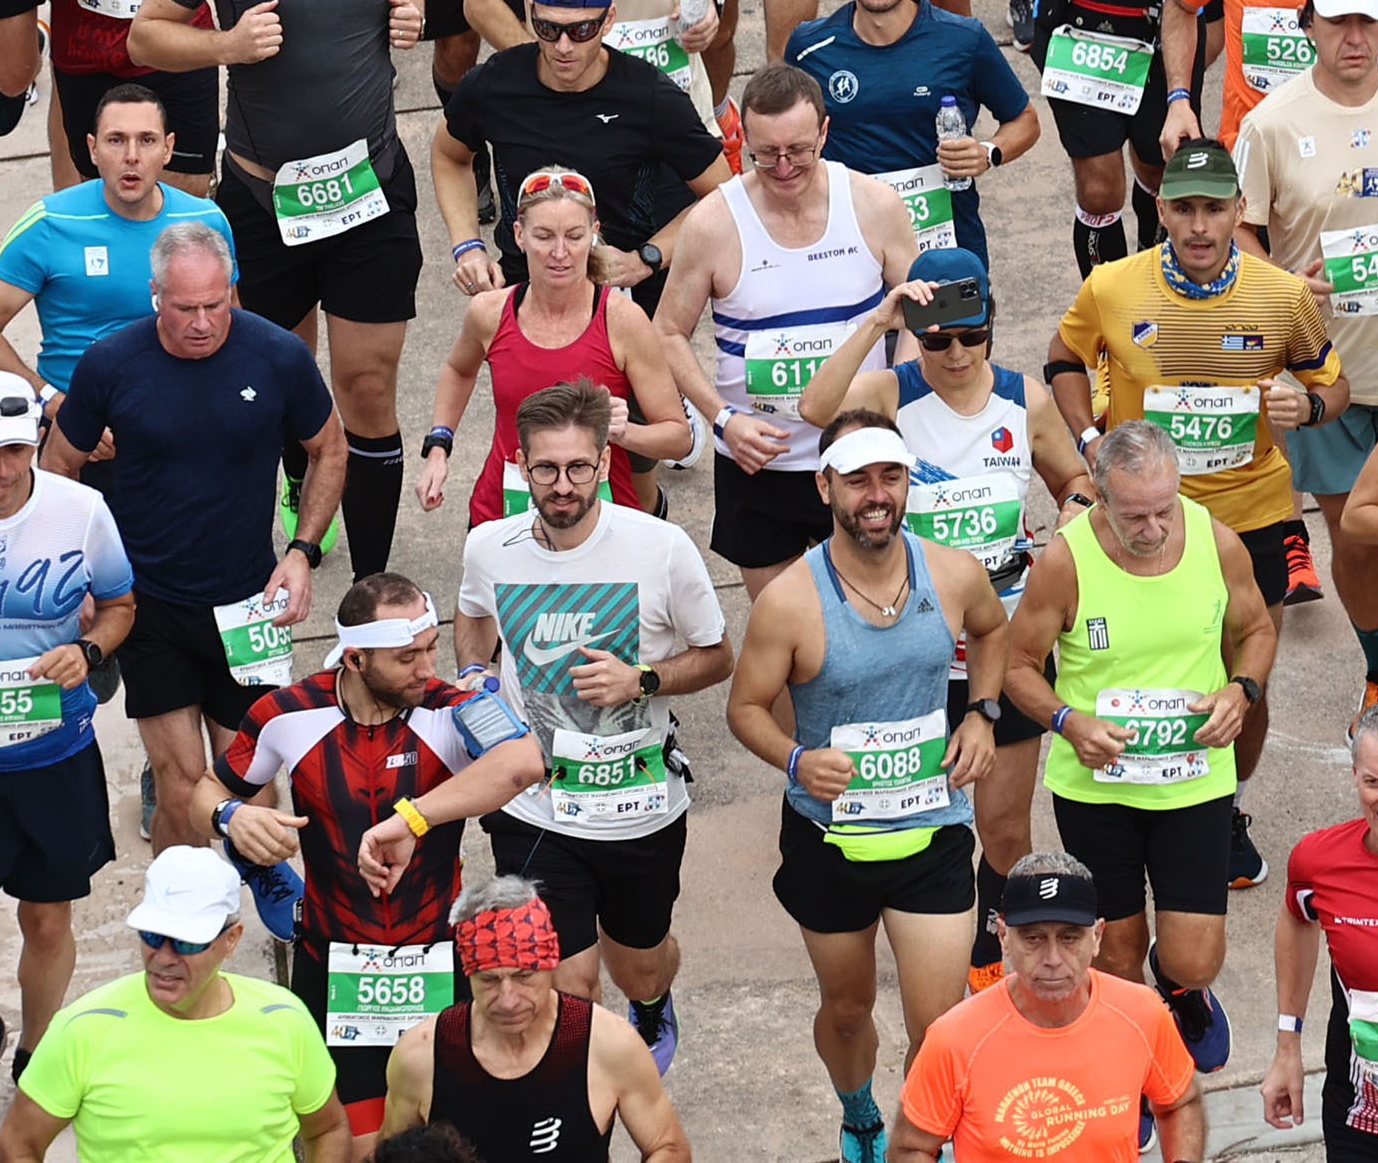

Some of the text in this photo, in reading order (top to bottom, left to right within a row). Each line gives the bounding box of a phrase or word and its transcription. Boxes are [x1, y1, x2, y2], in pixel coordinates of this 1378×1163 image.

[1072, 40, 1128, 74] 6854
[1267, 38, 1316, 62] 526
[298, 175, 354, 205] 6681
[807, 245, 858, 263] BEESTON AC
[1171, 415, 1231, 438] 5476
[983, 457, 1020, 467] TAIWAN
[933, 508, 994, 538] 5736
[533, 613, 597, 641] NIKE
[1126, 719, 1185, 745] 6792
[578, 753, 636, 784] 6851
[860, 748, 921, 779] 6088
[358, 976, 424, 1005] 5658
[1031, 1104, 1071, 1119] GLOBAL
[1046, 1102, 1130, 1126] RUNNING DAY
